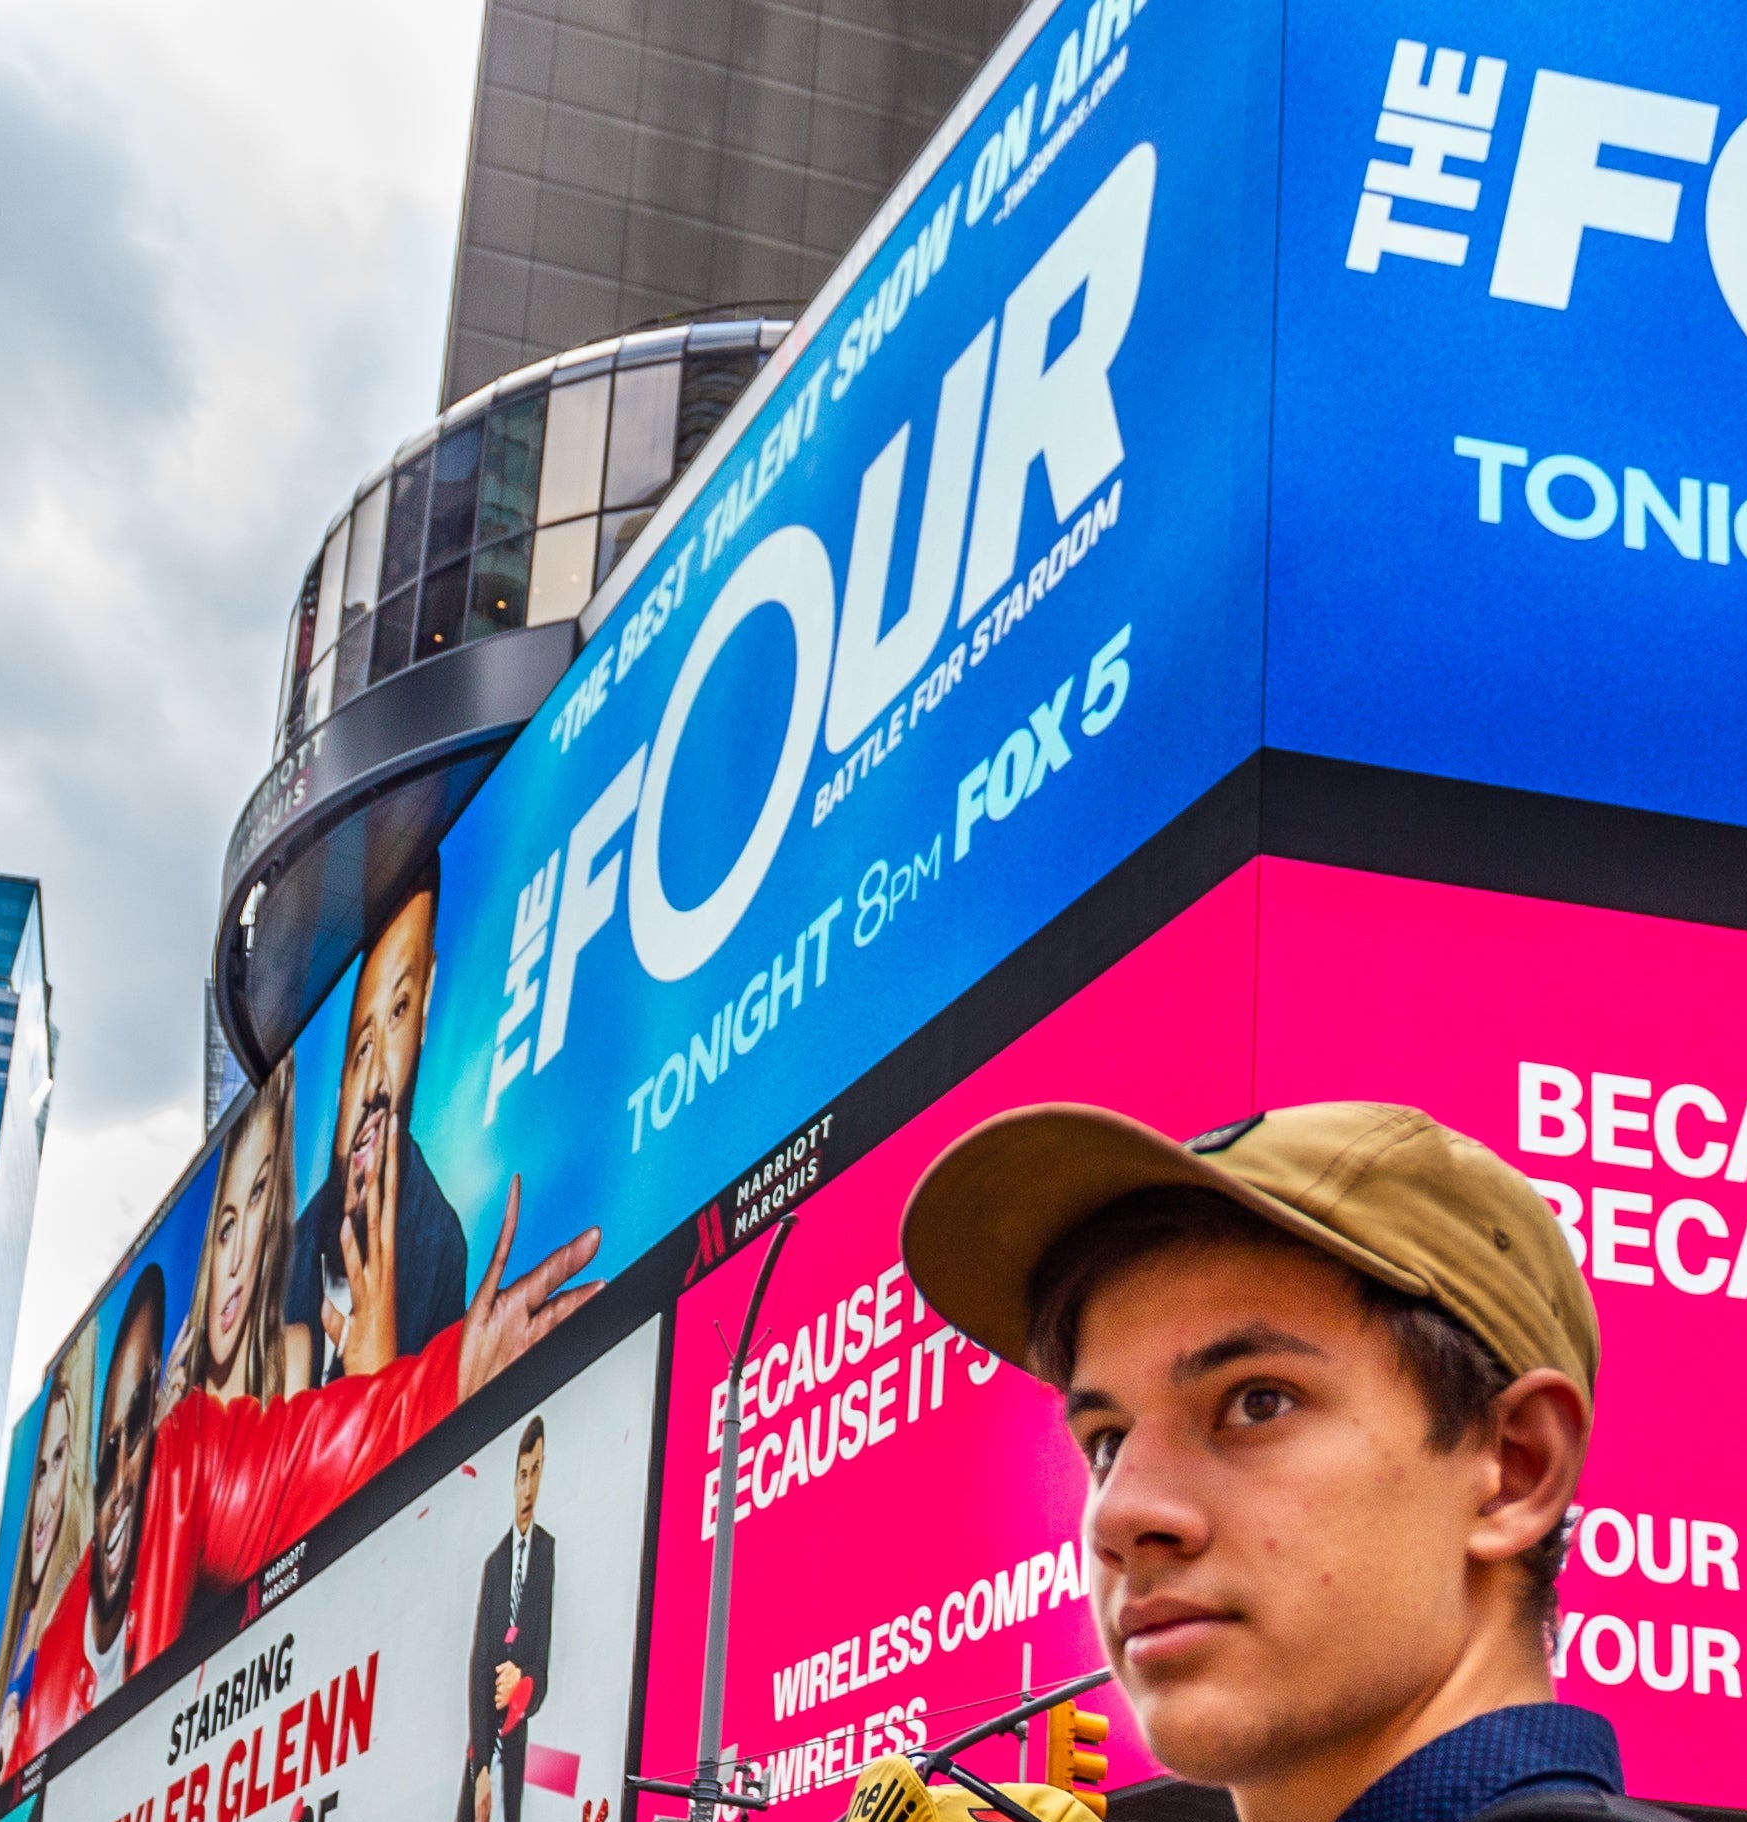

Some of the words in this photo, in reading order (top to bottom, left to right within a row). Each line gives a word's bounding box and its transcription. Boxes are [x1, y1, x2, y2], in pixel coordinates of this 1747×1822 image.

[1345, 39, 1507, 272] THE
[616, 543, 693, 681] BEST
[701, 359, 836, 575] TALENT
[833, 181, 961, 403] SHOW
[966, 81, 1038, 228] ON
[532, 142, 1156, 1075] FOUR
[812, 709, 904, 828] BATTLE
[910, 656, 963, 731] FOR
[970, 480, 1122, 666] STARDOM
[627, 897, 843, 1153] TONIGHT
[852, 834, 943, 949] 8PM
[954, 697, 1073, 862] FOX
[1081, 625, 1131, 736] 5
[482, 847, 560, 1128] THE
[733, 1157, 819, 1237] MARQUIS
[735, 1112, 833, 1207] MARRIOTT
[699, 1350, 899, 1542] BECAUSE
[908, 1328, 1001, 1422] IT'S
[706, 1259, 907, 1453] BECAUSE
[261, 1568, 299, 1608] MARQUIS
[264, 1541, 306, 1586] MARRIOTT
[167, 1632, 294, 1766] STARRING
[768, 1696, 927, 1805] WIRELESS
[771, 1605, 932, 1722] WIRELESS
